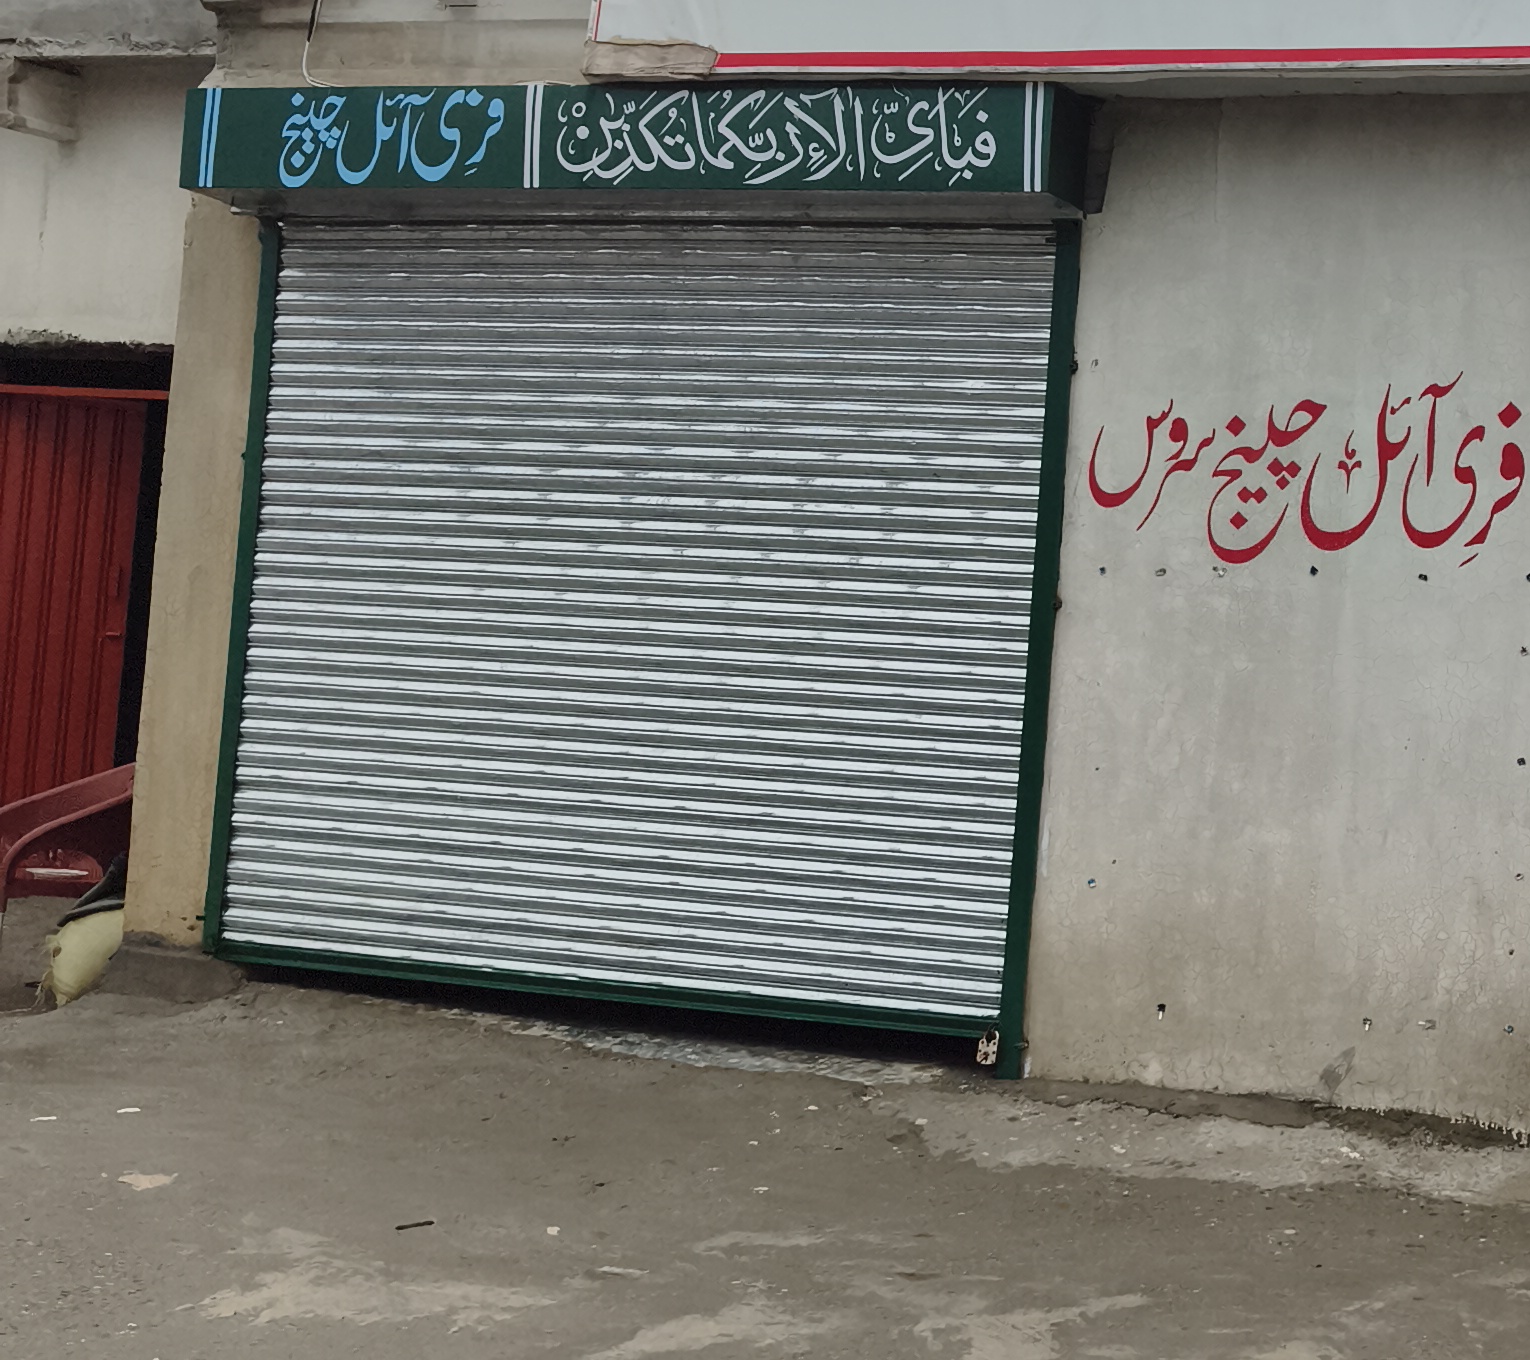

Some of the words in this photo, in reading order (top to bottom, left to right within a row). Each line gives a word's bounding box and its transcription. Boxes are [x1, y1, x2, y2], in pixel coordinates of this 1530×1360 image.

[278, 89, 347, 188] چینج
[1087, 398, 1216, 533] سروس
[1207, 398, 1328, 565] چینج
